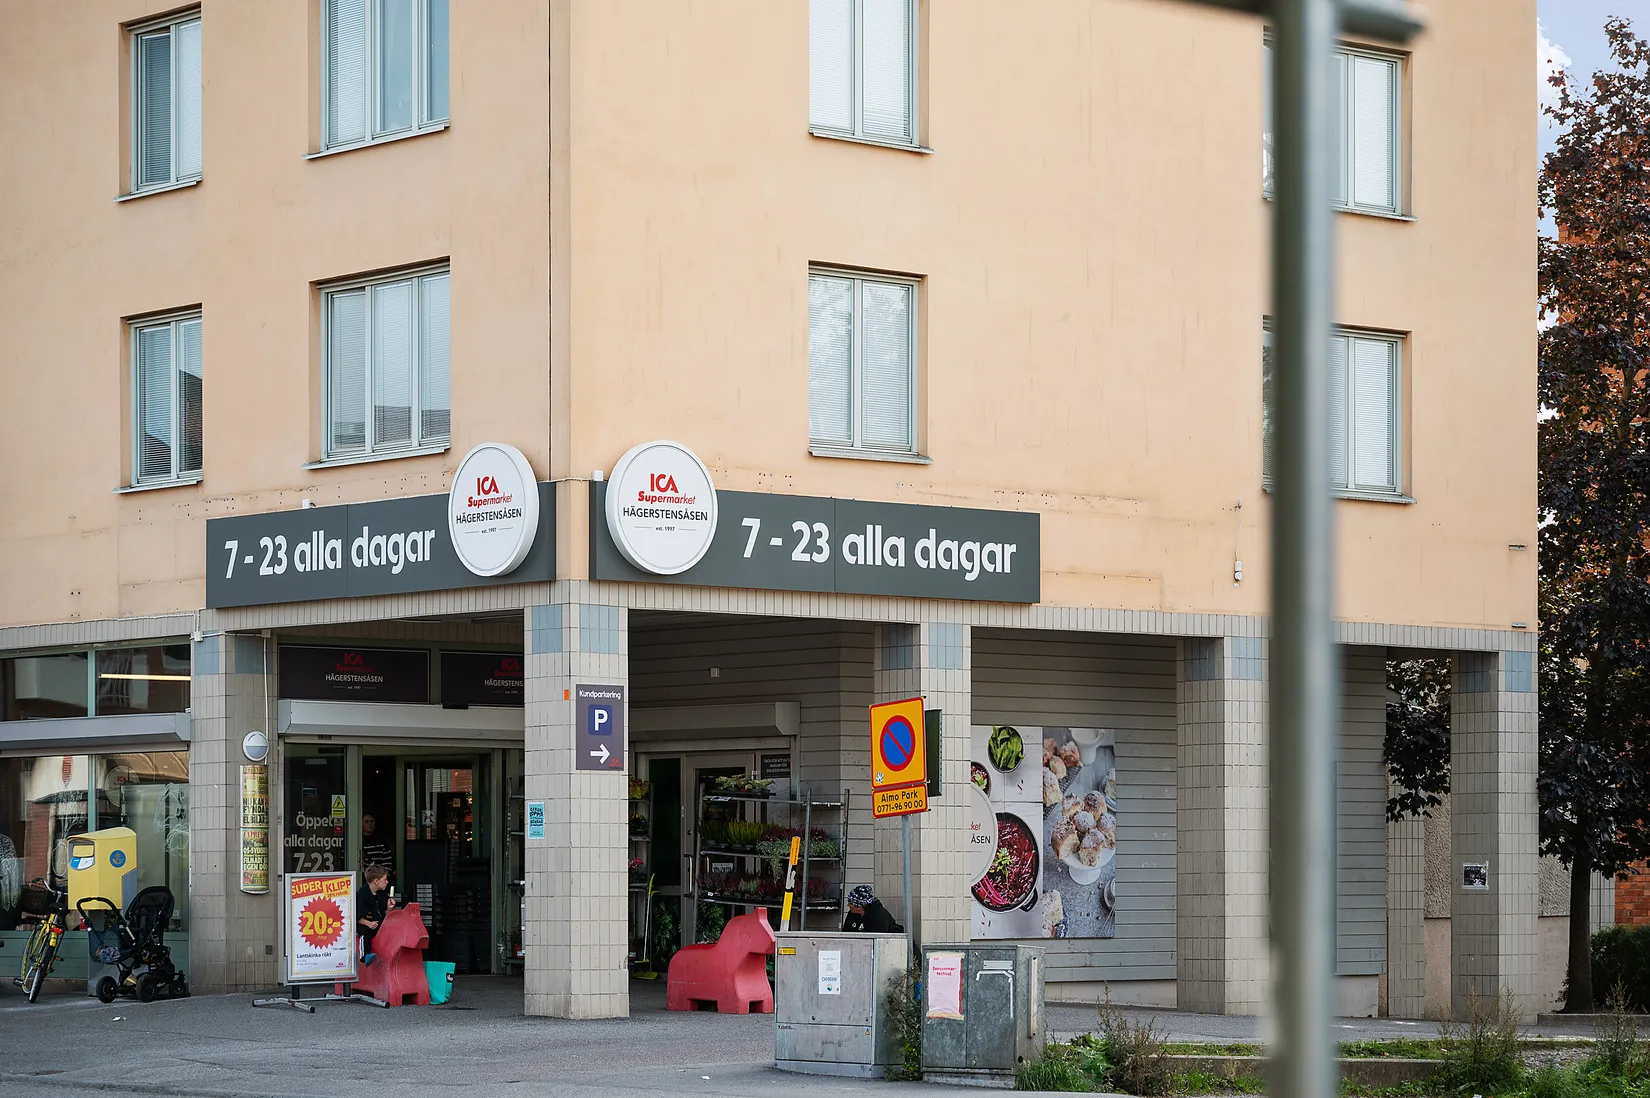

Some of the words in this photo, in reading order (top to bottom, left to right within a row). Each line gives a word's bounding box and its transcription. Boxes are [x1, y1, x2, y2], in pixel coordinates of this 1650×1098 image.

[476, 476, 500, 496] ICA
[649, 473, 679, 493] ICA
[468, 492, 512, 508] Supermarket
[637, 490, 696, 504] Supermarket
[456, 506, 522, 524] HÄGERSTENSÅSEN
[622, 505, 708, 521] HÄGERSTENSÅSEN
[224, 540, 238, 580] 7
[259, 534, 288, 576] 23
[294, 529, 342, 574] alla
[350, 526, 435, 575] dagar
[740, 518, 761, 558] 7
[790, 520, 830, 564] 23
[842, 524, 906, 567] alla
[914, 528, 1017, 582] dagar
[344, 652, 364, 665] ICA
[502, 658, 520, 670] ICA
[326, 672, 384, 683] HÄGERSTENSÅSEN
[579, 690, 622, 700] Kundparkering
[594, 709, 608, 731] P
[881, 793, 899, 803] Aimo
[902, 790, 918, 800] Park
[876, 802, 903, 813] 0771-96
[904, 802, 913, 810] 90
[914, 800, 924, 808] 00
[296, 811, 334, 830] Öppet
[284, 834, 306, 848] alla
[308, 834, 344, 850] dagar
[294, 852, 335, 873] 7-23
[292, 880, 322, 896] SUPER
[302, 911, 340, 935] 20:-
